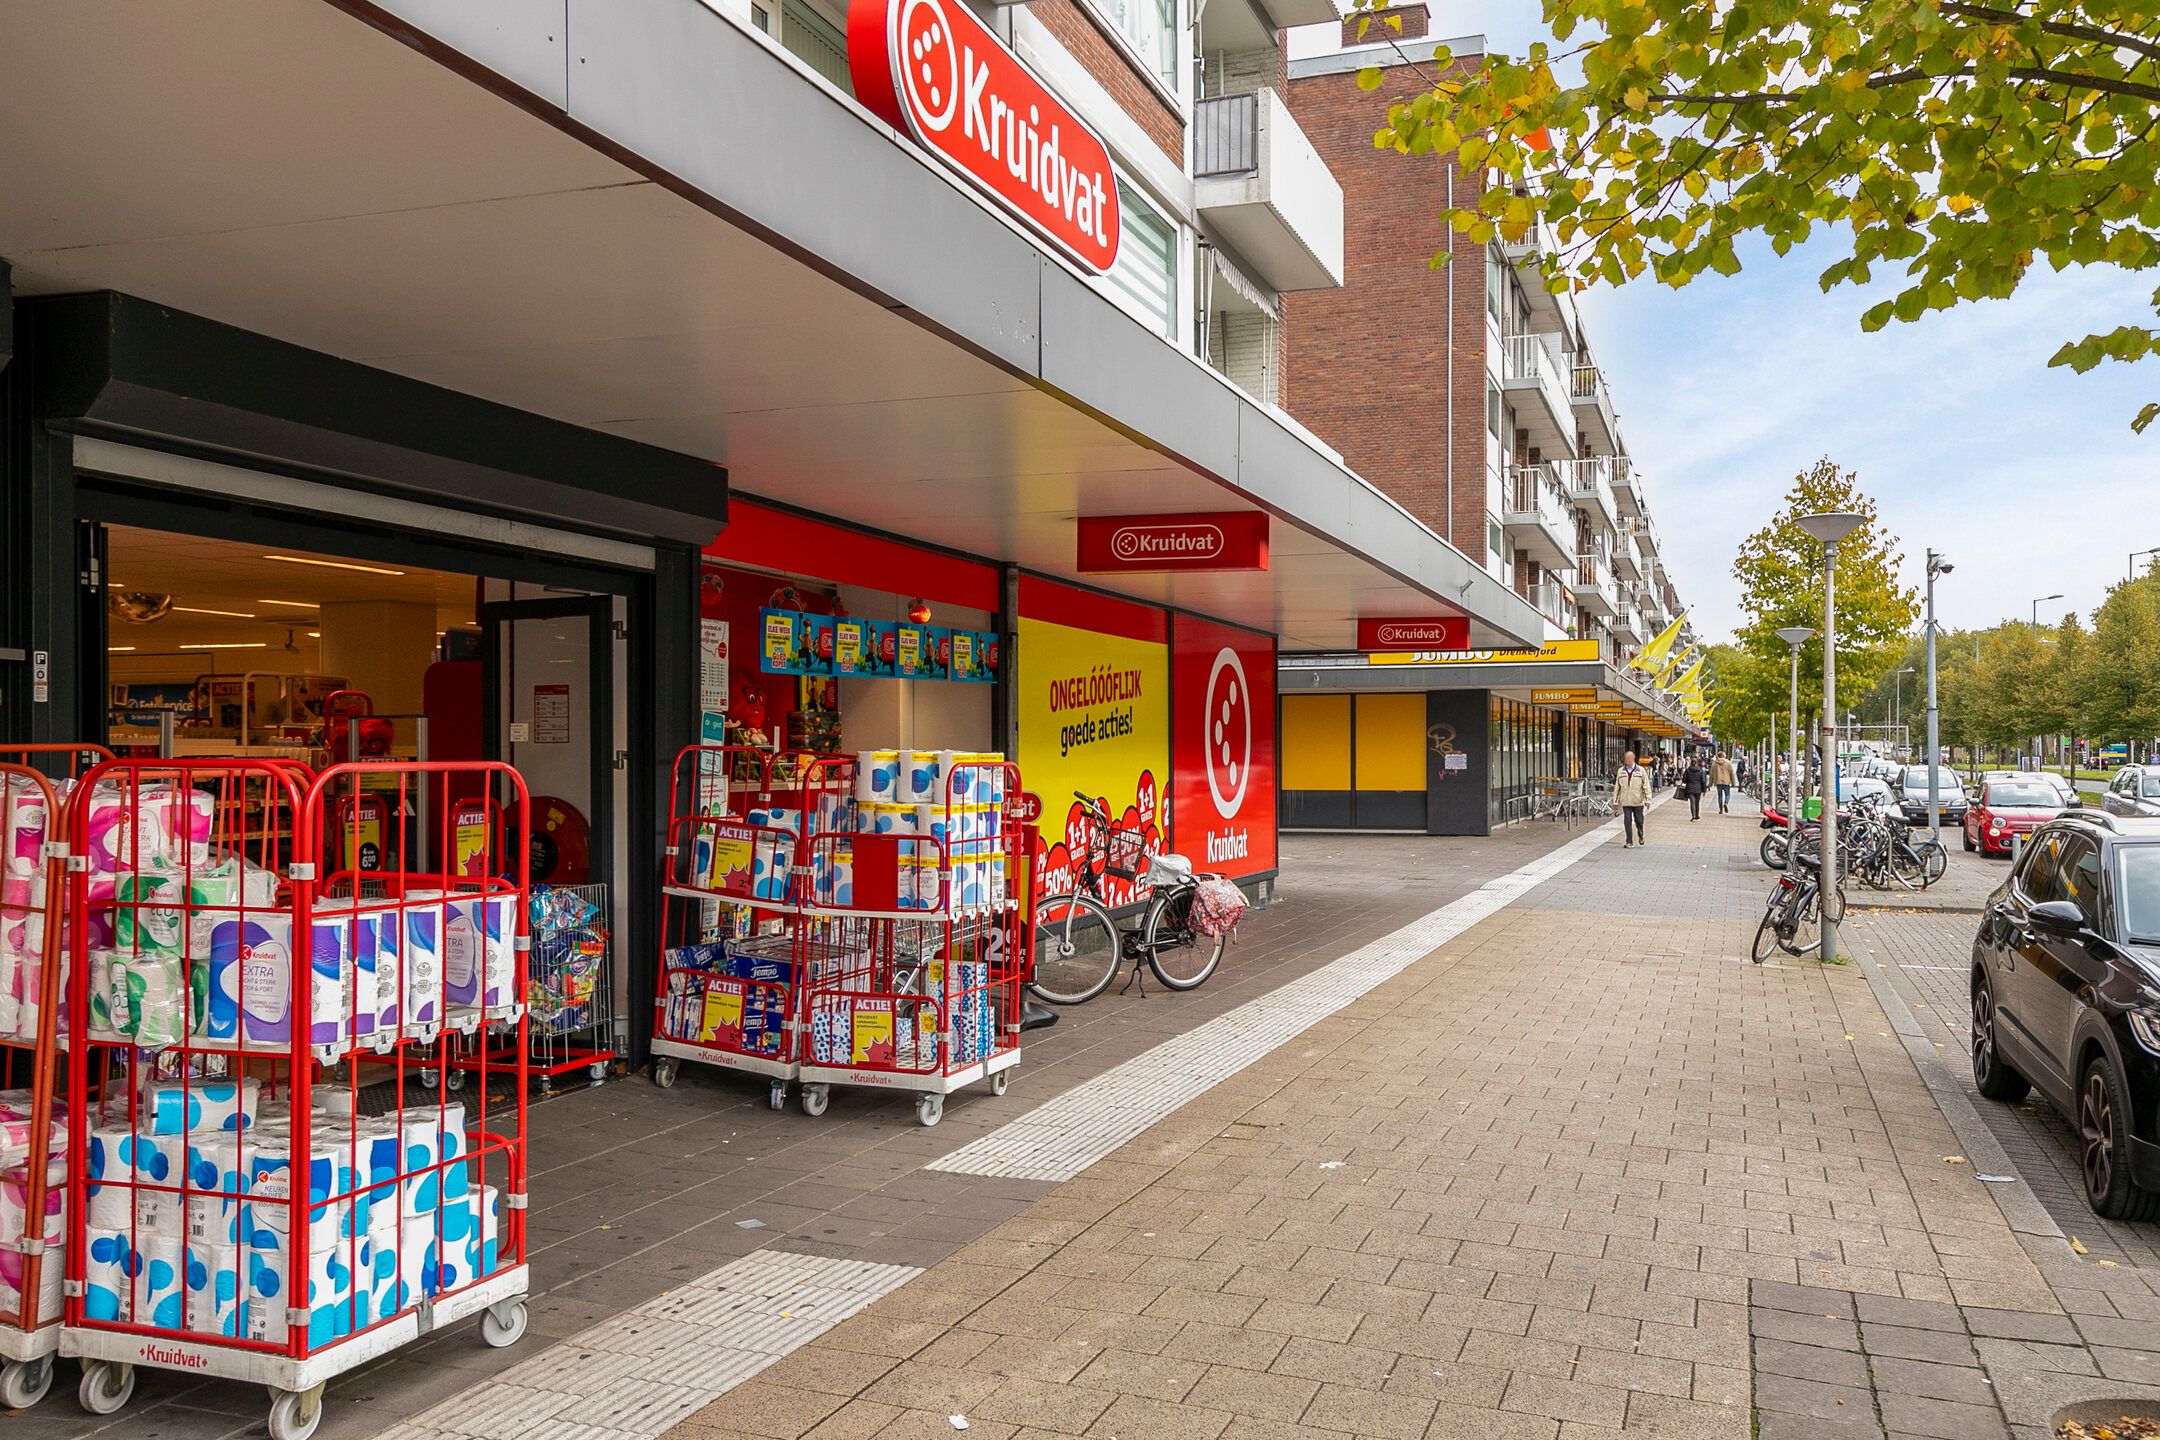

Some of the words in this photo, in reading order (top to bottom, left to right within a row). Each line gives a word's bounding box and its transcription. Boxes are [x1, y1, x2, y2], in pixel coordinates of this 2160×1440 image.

[964, 45, 1108, 248] Kruidvat
[1140, 532, 1214, 551] Kruidvat
[1395, 627, 1440, 640] Kruidvat
[1049, 663, 1142, 713] ONGELÓÓÓFLIJK
[1535, 692, 1570, 700] JUMBO
[704, 718, 722, 730] drgist
[1061, 713, 1096, 757] goede
[1098, 706, 1133, 741] acties!
[1138, 783, 1155, 814] 1+1
[348, 809, 376, 822] ATIE!
[719, 826, 753, 841] ACTIE!
[1067, 815, 1087, 851] 1+1
[1207, 826, 1249, 864] Kruidvat
[1046, 863, 1073, 898] 50%
[446, 937, 464, 948] TRA
[253, 952, 277, 961] Kruidvat
[751, 966, 779, 979] Tempo
[708, 979, 743, 995] ACTIE!
[855, 998, 891, 1011] ACTIE!
[744, 1014, 767, 1028] Temp
[702, 1050, 734, 1065] Kruidvat
[853, 1072, 888, 1085] Kruidvat
[146, 1344, 202, 1368] Kruidvat
